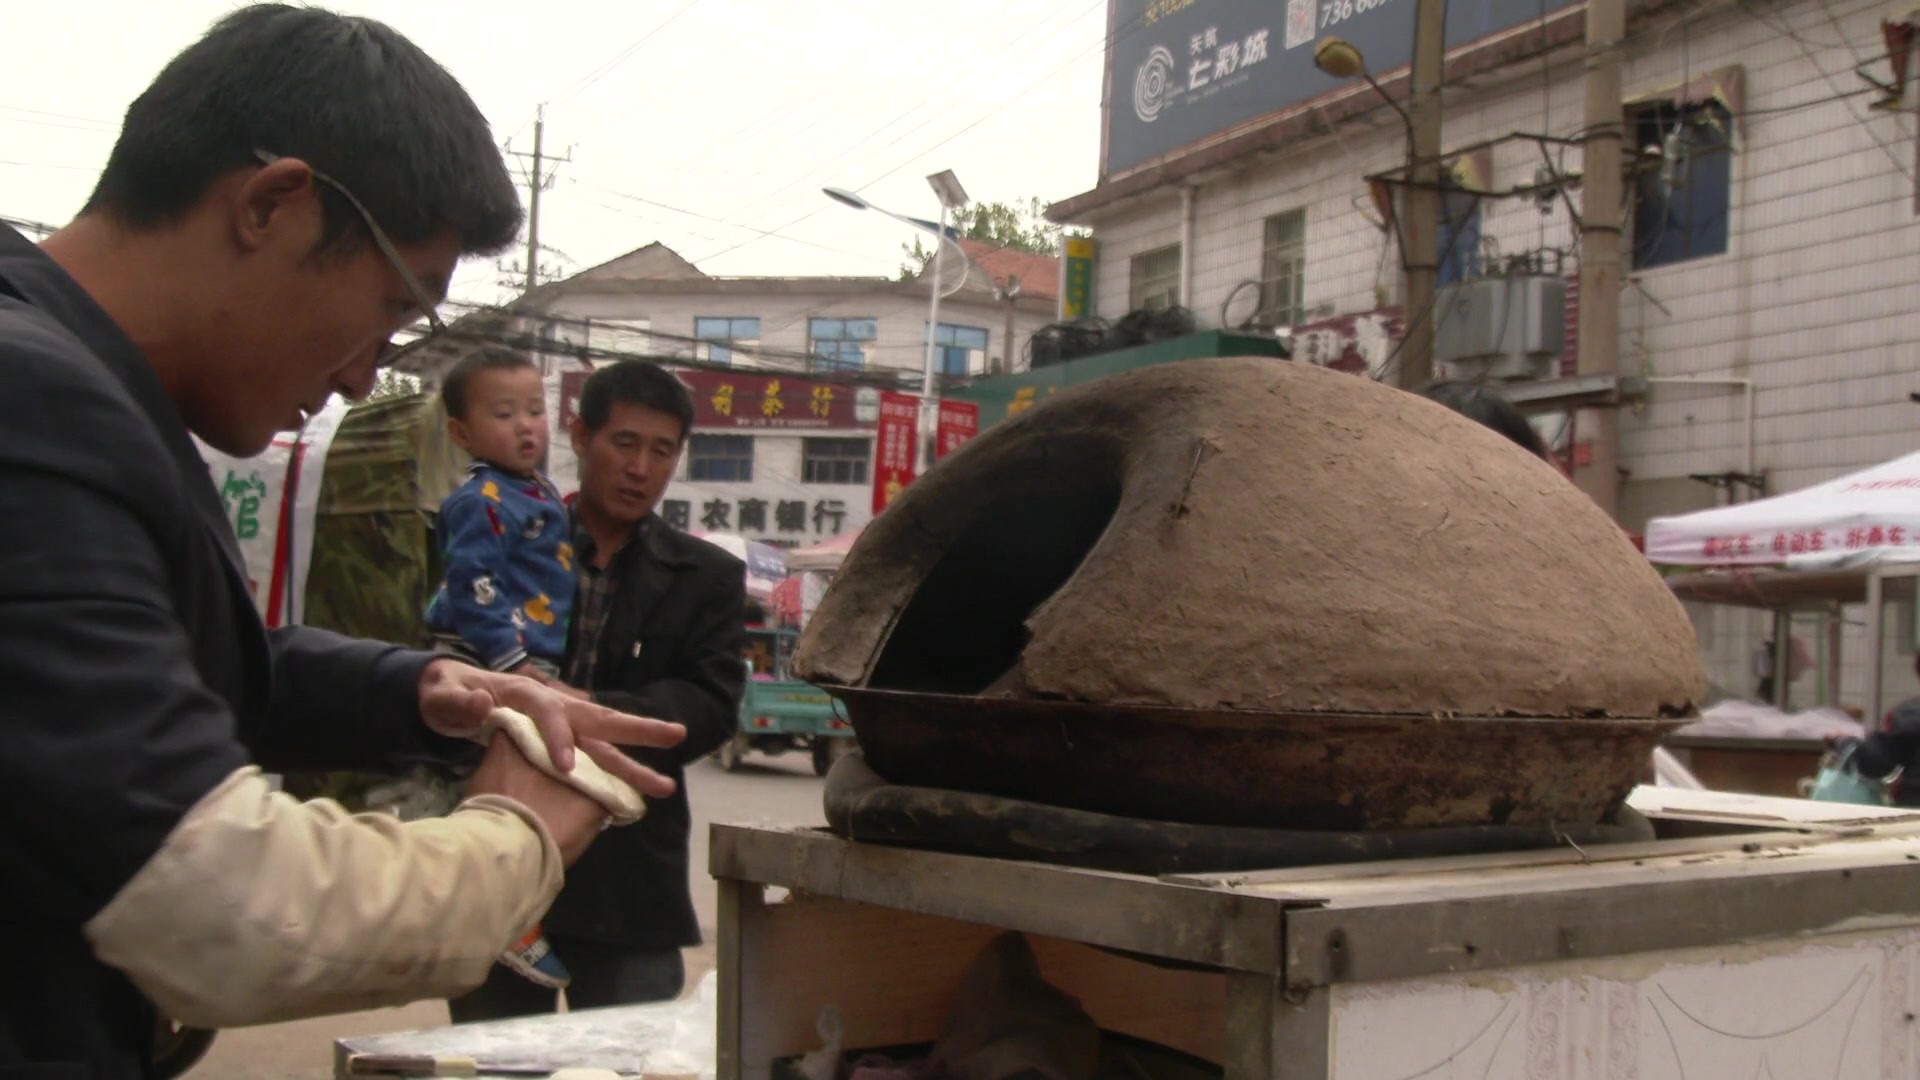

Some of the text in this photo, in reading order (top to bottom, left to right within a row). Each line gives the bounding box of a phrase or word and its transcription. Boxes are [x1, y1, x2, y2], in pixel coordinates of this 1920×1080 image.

[1320, 0, 1353, 29] 736
[1189, 29, 1269, 90] 七彩城
